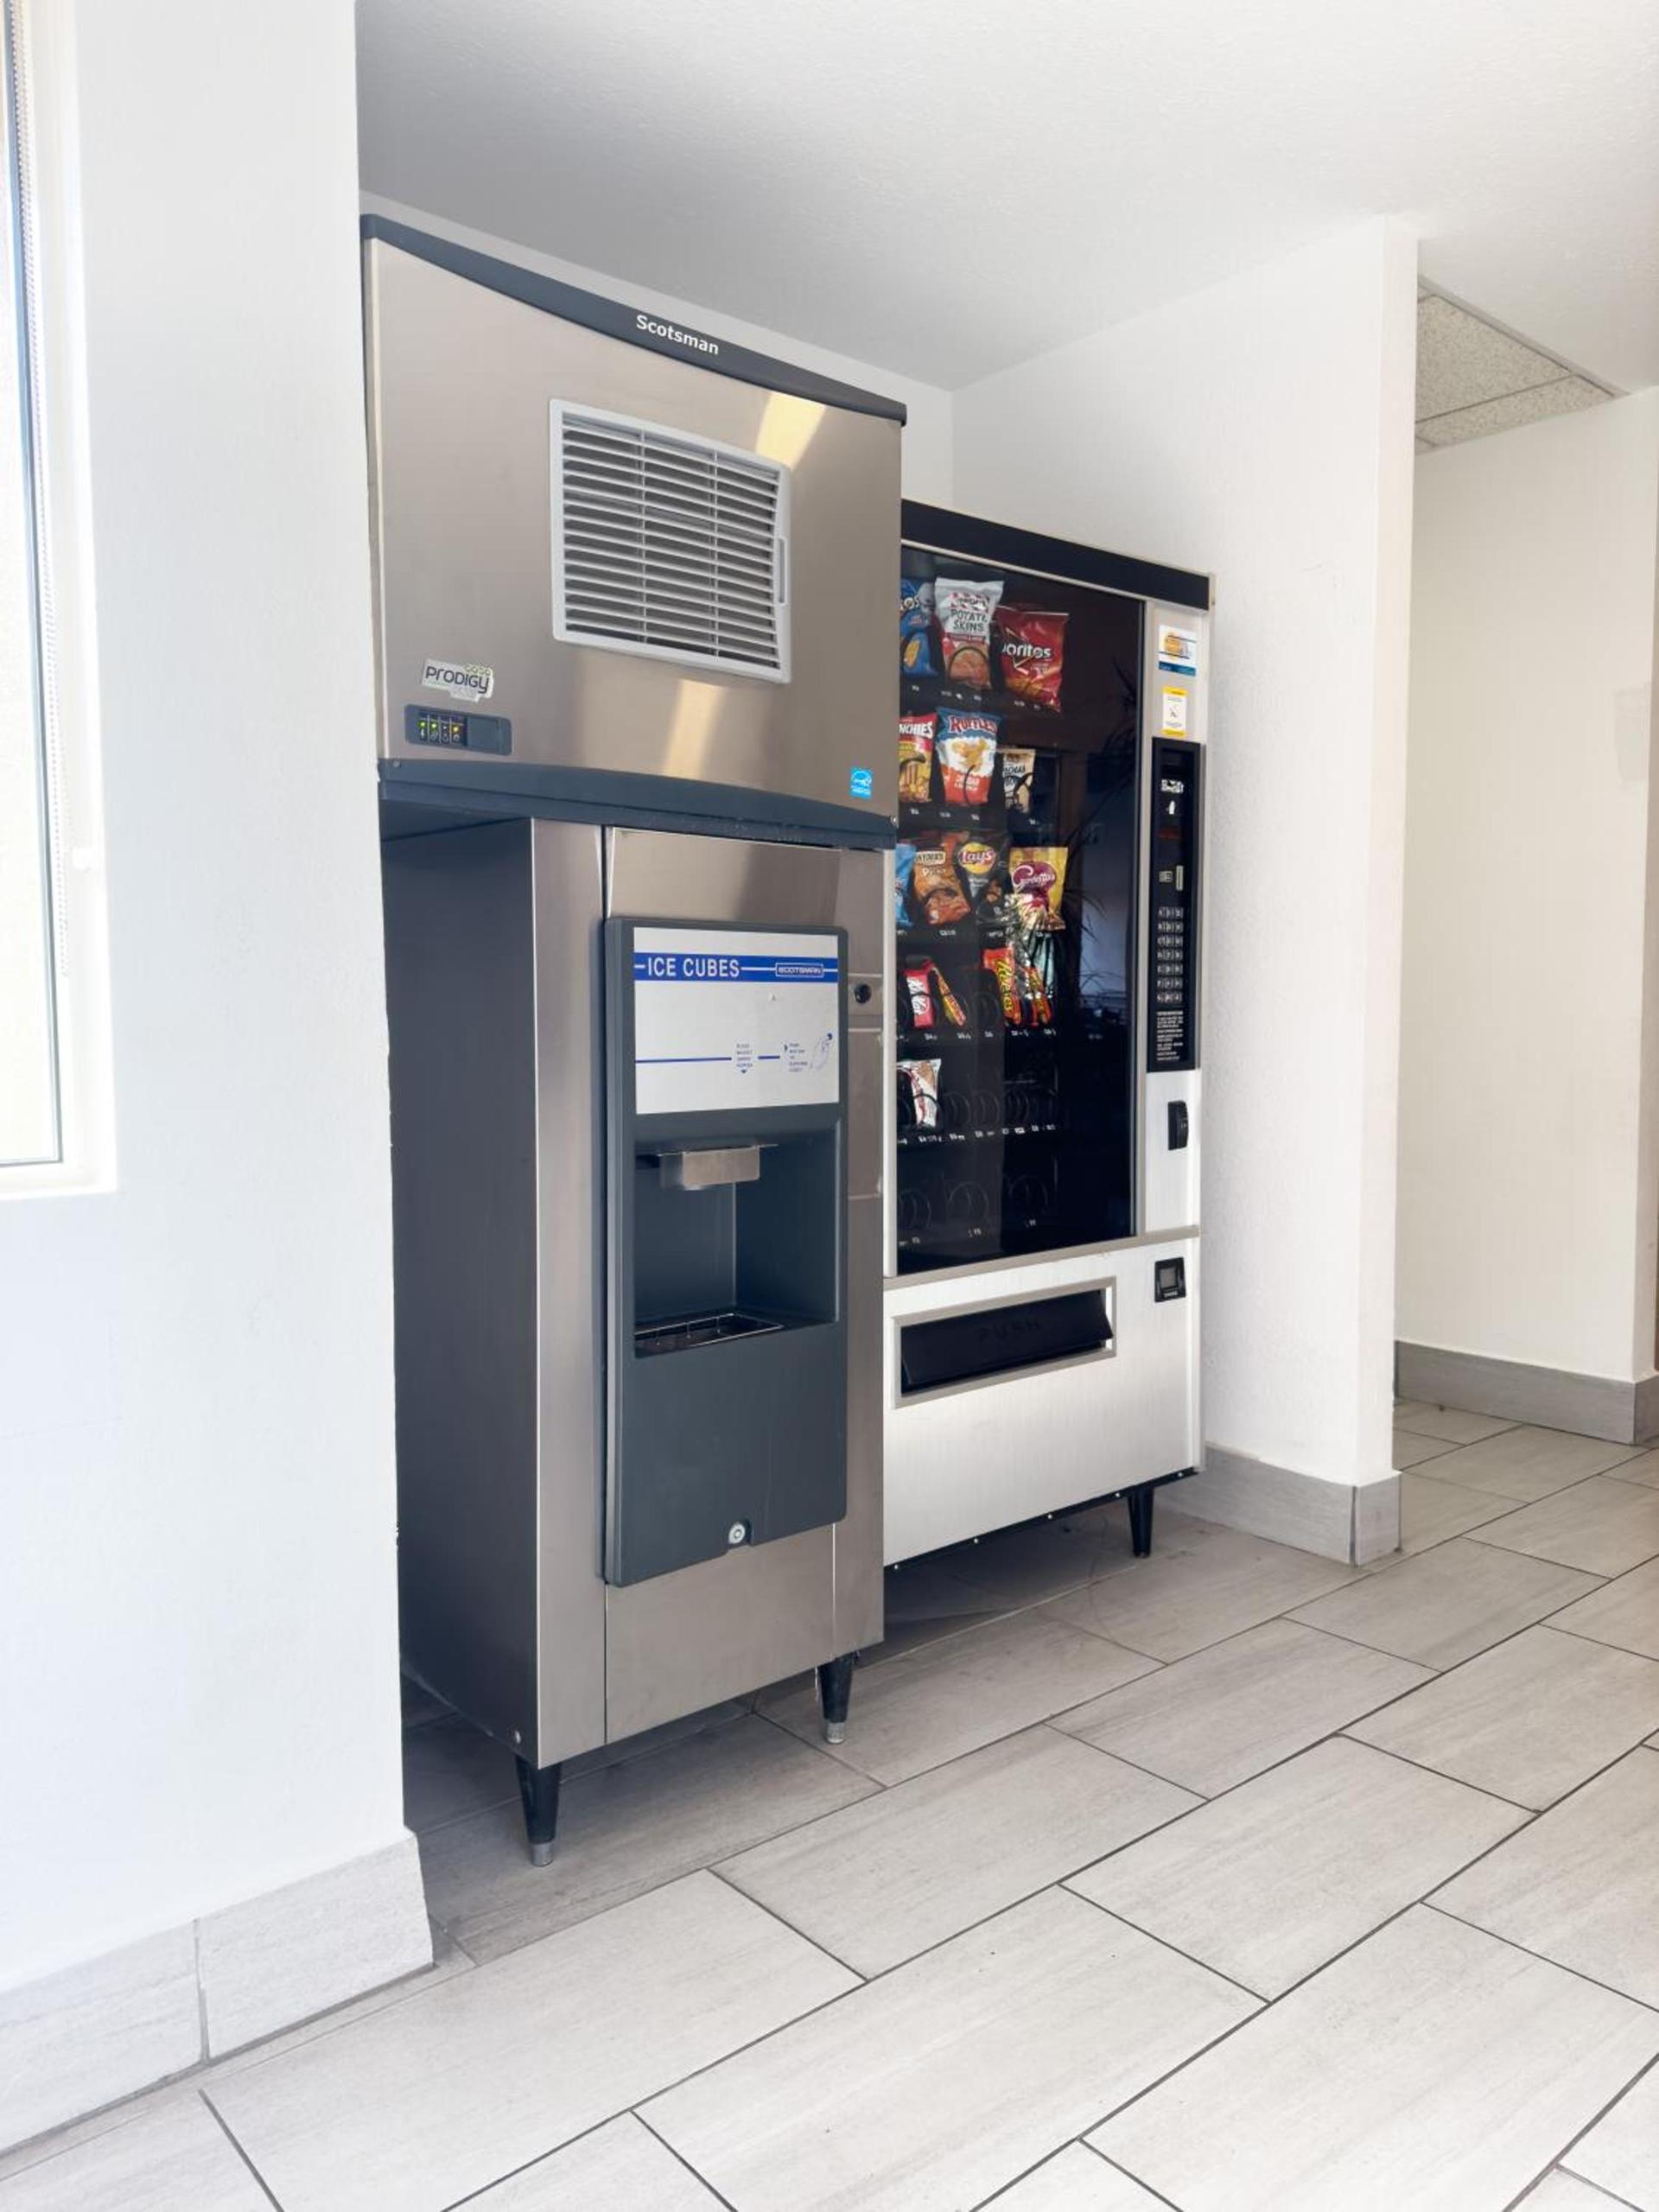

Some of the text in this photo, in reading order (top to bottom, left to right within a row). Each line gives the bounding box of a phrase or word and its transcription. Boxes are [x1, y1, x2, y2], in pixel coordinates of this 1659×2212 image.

[636, 315, 720, 355] Scotsman
[952, 619, 985, 632] SKINS
[899, 722, 934, 739] NCHIES
[647, 957, 741, 978] ICE CUBES
[778, 965, 822, 976] SCOTSMAN
